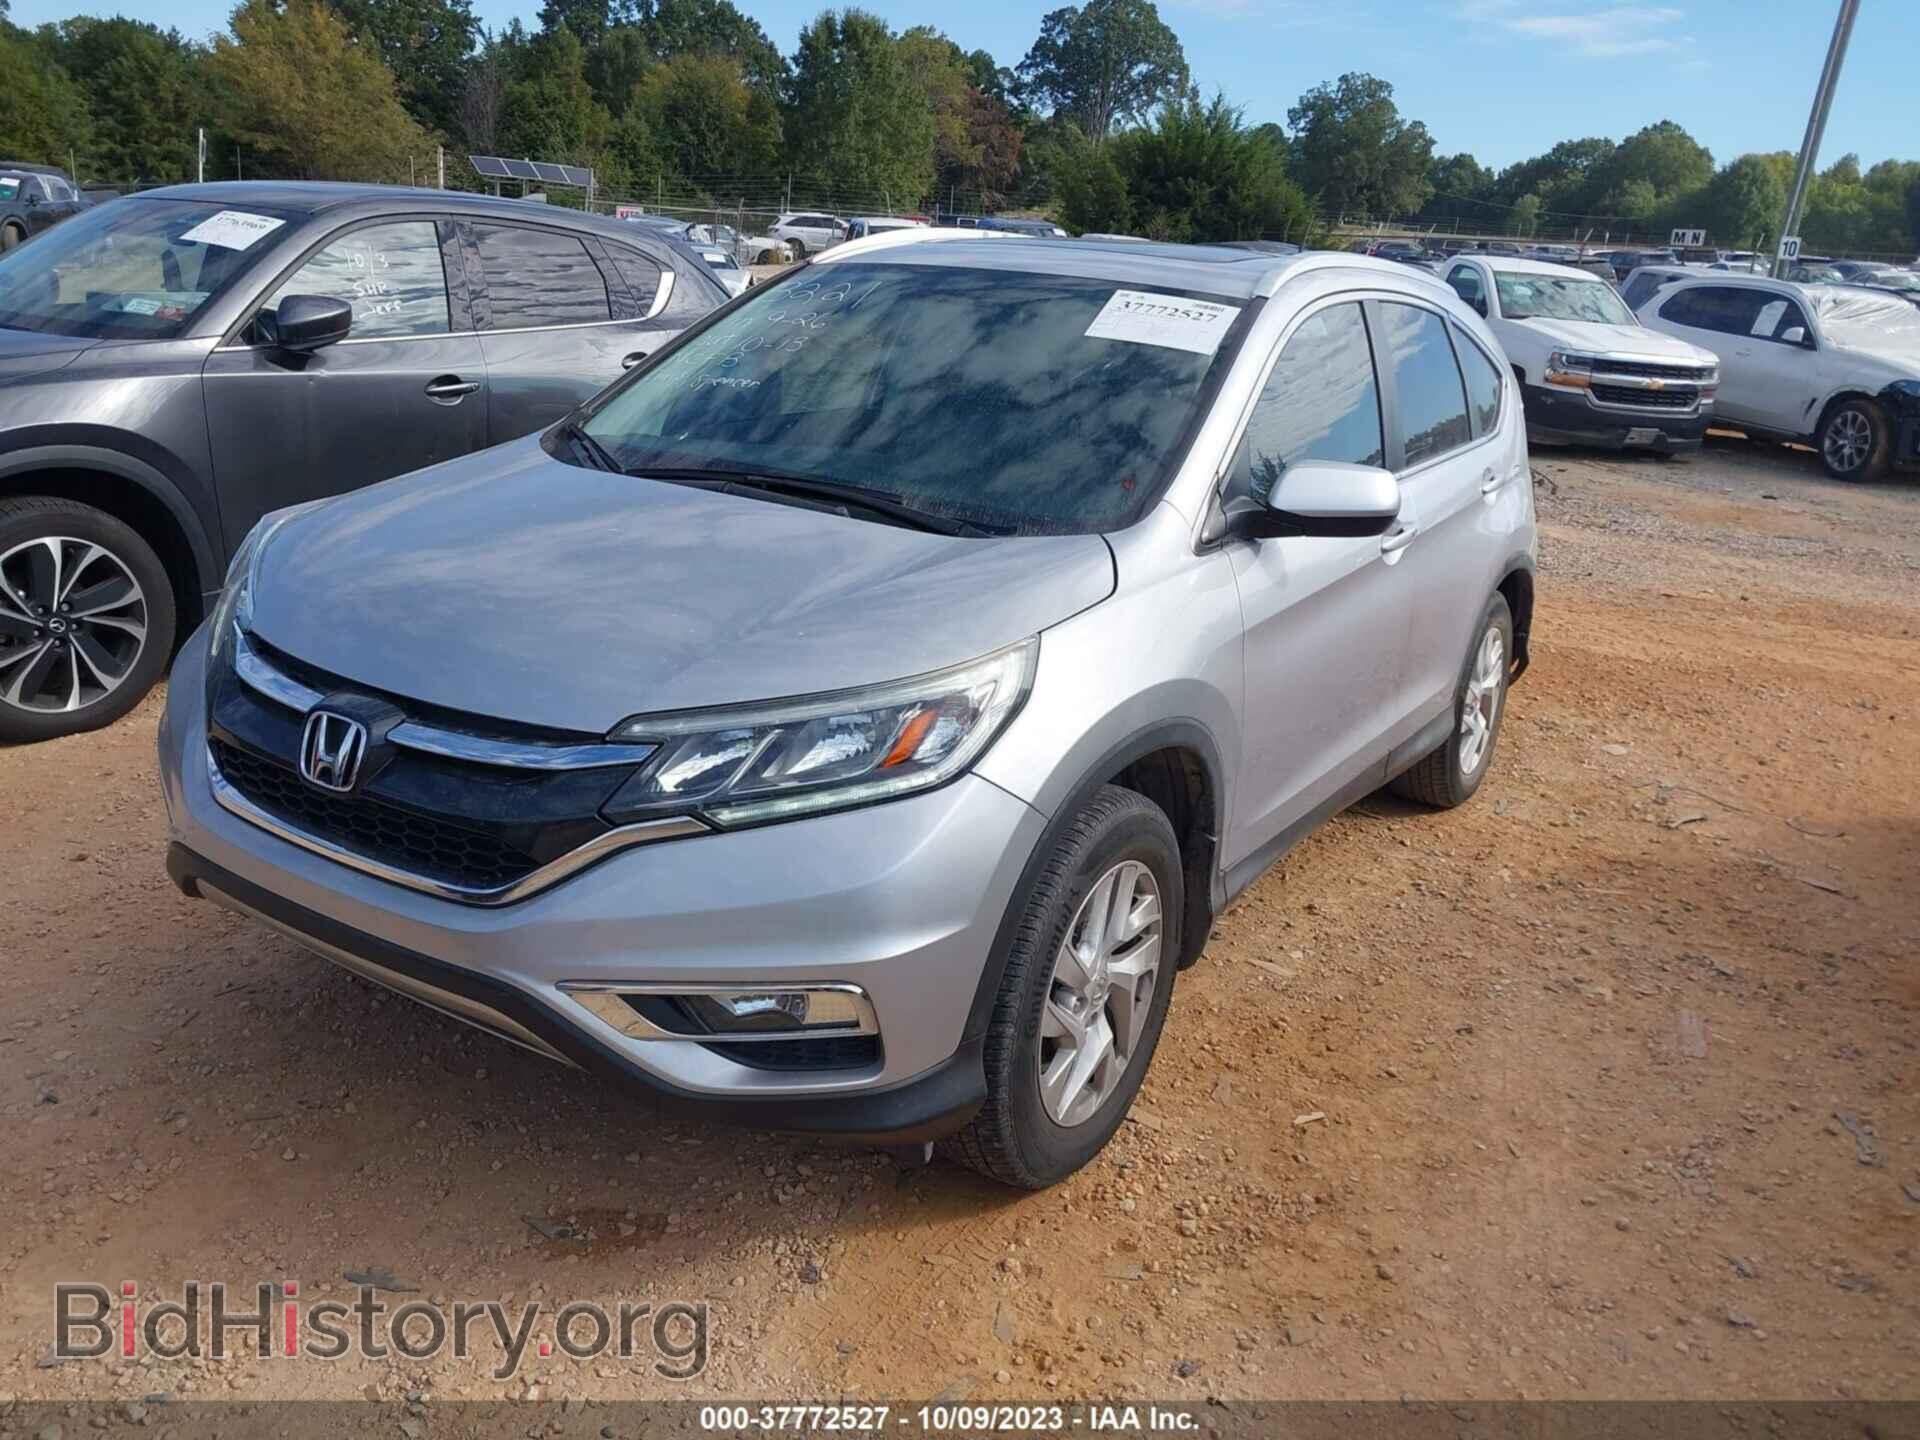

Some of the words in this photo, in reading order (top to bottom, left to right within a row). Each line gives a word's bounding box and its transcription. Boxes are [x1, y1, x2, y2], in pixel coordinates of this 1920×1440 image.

[1673, 231, 1686, 244] M
[1690, 231, 1701, 245] N
[1783, 240, 1798, 257] 10
[768, 310, 830, 329] 9-26
[1119, 300, 1218, 322] 37772527
[736, 335, 809, 352] 10-13
